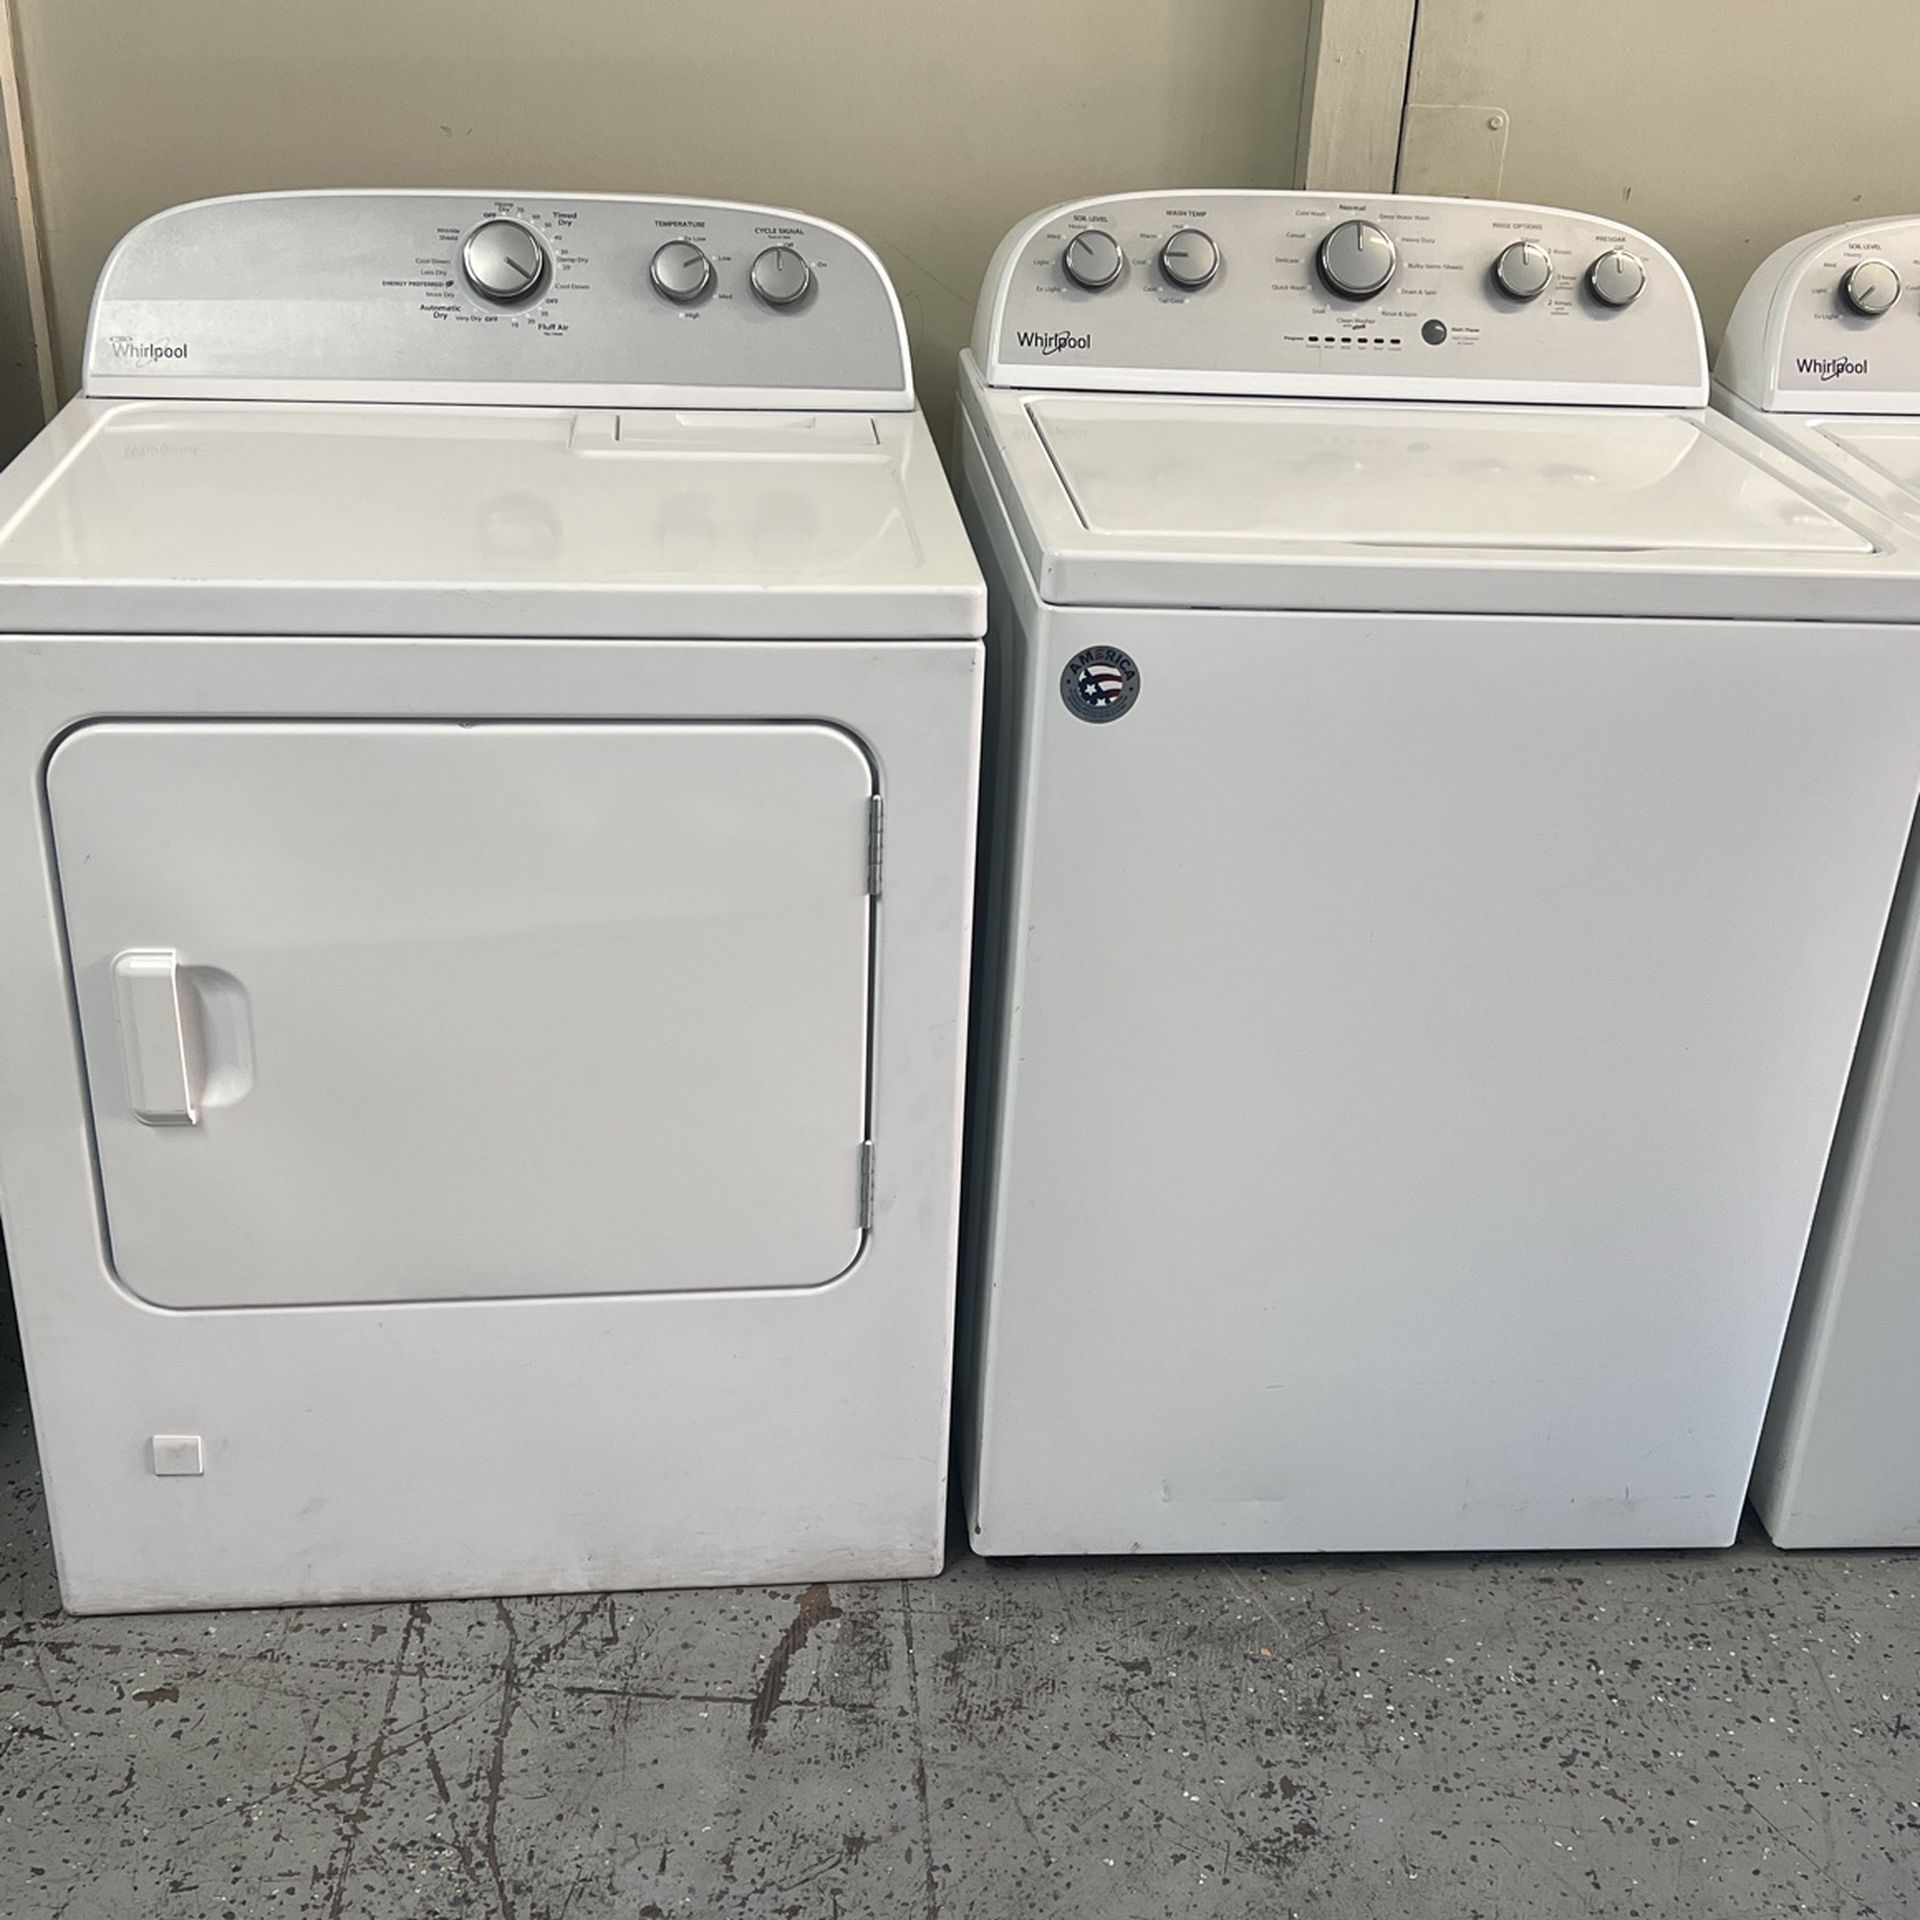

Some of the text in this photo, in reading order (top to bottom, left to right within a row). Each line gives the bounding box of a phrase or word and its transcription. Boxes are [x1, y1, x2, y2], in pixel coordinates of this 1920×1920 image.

[112, 341, 187, 365] Whirlpool
[1017, 331, 1091, 355] Whirlpool
[1797, 357, 1867, 381] Whirlpool
[1070, 649, 1135, 681] AMERICA
